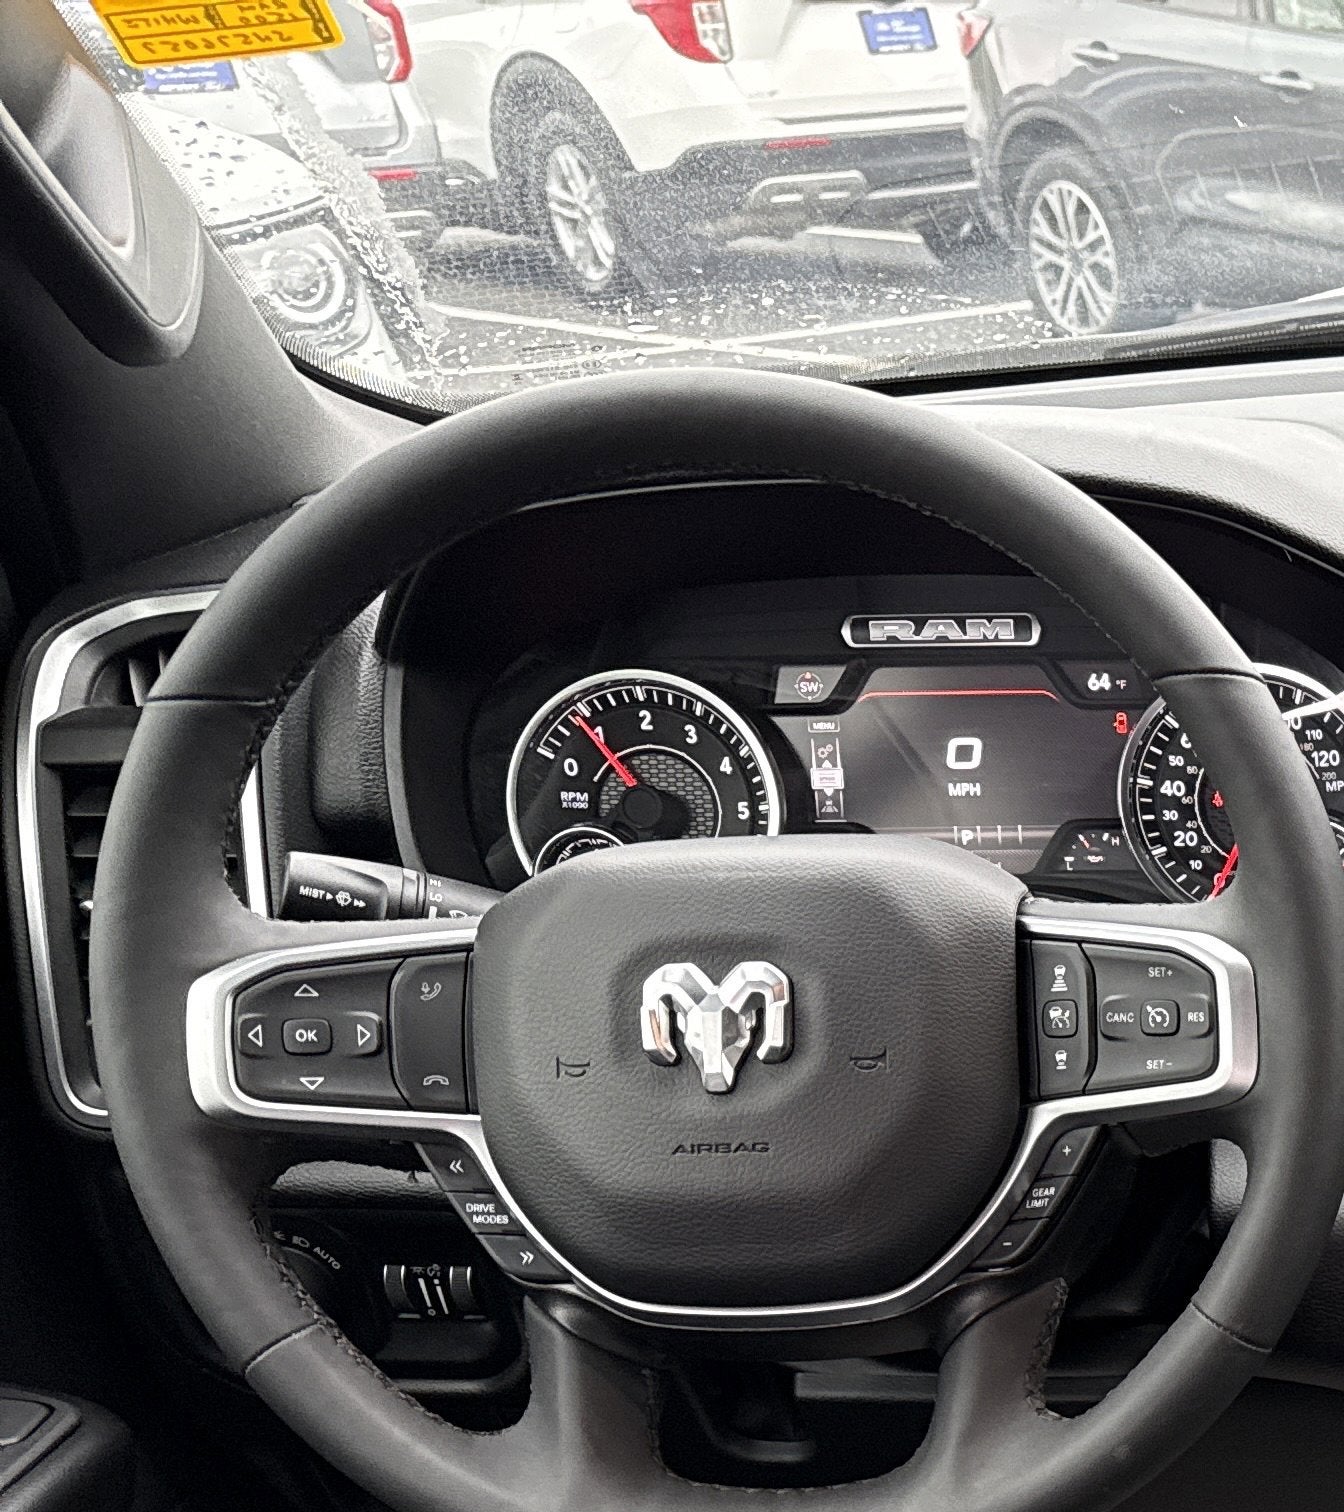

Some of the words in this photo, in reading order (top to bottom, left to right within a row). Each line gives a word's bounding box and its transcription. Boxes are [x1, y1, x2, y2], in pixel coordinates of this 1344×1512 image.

[868, 618, 1015, 641] RAM
[800, 681, 819, 693] SW
[1087, 673, 1111, 691] 64
[638, 710, 653, 730] 2
[813, 721, 835, 730] MENU
[684, 724, 698, 744] 3
[1305, 729, 1323, 741] 110
[1168, 755, 1184, 767] 50
[1311, 750, 1340, 767] 120
[563, 758, 578, 776] 0
[719, 757, 733, 774] 4
[1321, 772, 1337, 781] 200
[948, 783, 981, 797] MPH
[1160, 780, 1186, 797] 40
[560, 791, 589, 802] RPM
[1181, 796, 1193, 805] 60
[737, 802, 750, 820] 5
[1162, 810, 1179, 821] 30
[1186, 821, 1198, 829] 40
[961, 829, 975, 846] P
[1111, 836, 1120, 846] H
[1173, 831, 1198, 847] 20
[1200, 845, 1213, 854] 20
[1066, 861, 1073, 871] L
[1189, 860, 1203, 870] 10
[299, 885, 325, 900] MIST
[429, 892, 443, 903] LO
[1106, 1012, 1135, 1023] CANC
[1187, 1012, 1205, 1022] RES
[295, 1029, 318, 1043] OK
[671, 1141, 770, 1156] AIRBAG
[1032, 1187, 1055, 1198] GEAR
[465, 1203, 496, 1214] DRIVE
[1025, 1198, 1050, 1209] LIMIT
[472, 1214, 509, 1225] MODES
[313, 1246, 341, 1270] AUTO
